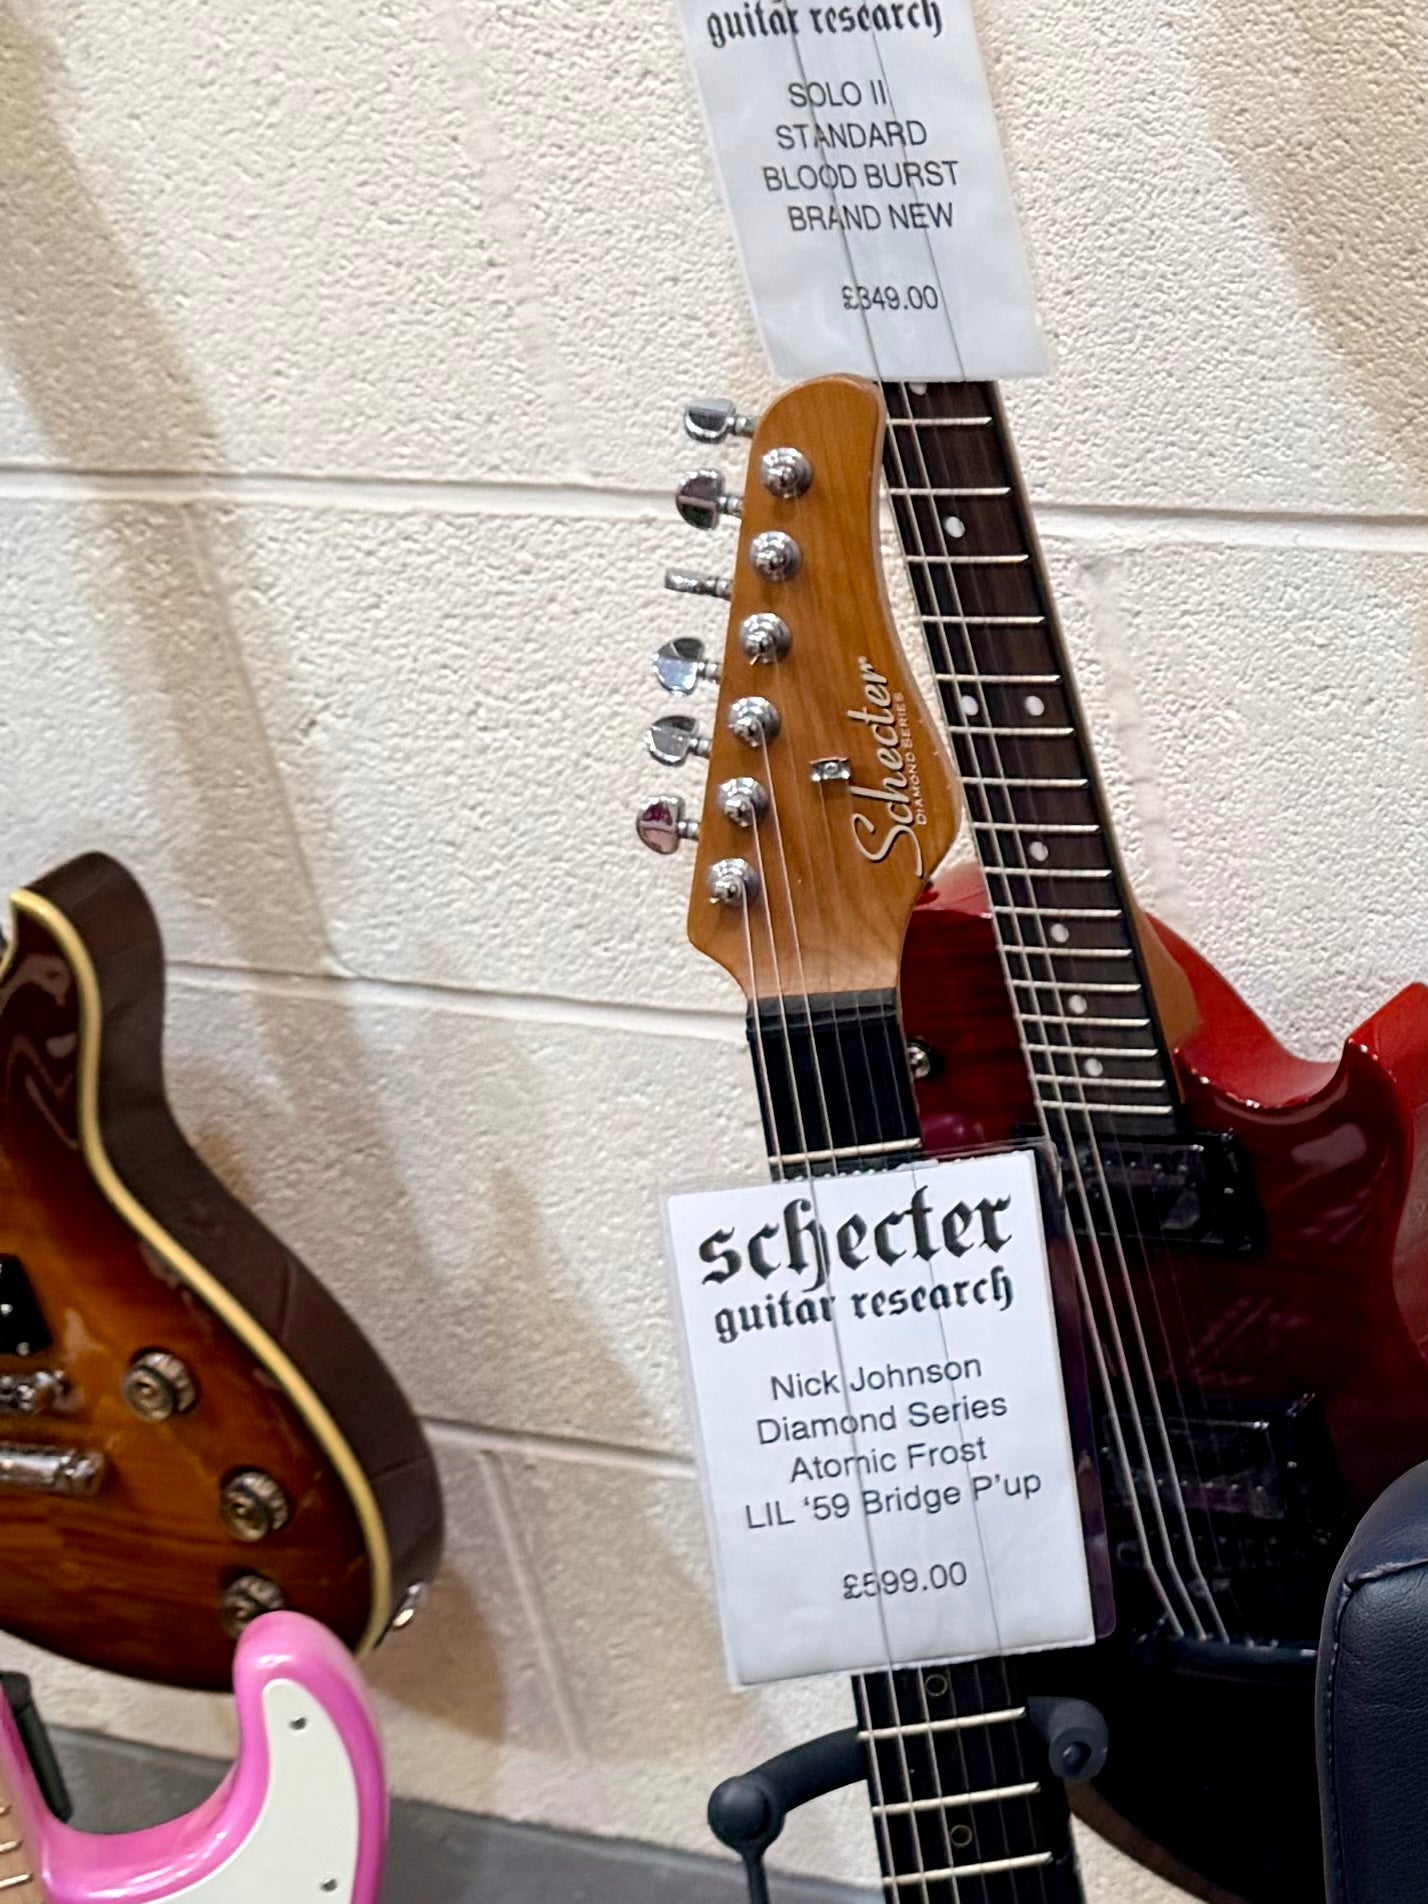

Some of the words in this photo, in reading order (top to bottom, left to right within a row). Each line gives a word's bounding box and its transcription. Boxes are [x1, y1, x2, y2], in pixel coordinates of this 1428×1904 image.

[788, 81, 862, 108] SOLO
[776, 120, 927, 150] STANDARD
[762, 163, 858, 192] BLOOD
[866, 160, 959, 188] BURST
[789, 204, 882, 233] BRAND
[891, 202, 954, 229] NEW
[892, 692, 914, 748] SERIES
[847, 656, 924, 878] Schecter
[907, 752, 928, 826] DIAMOND
[698, 1184, 1013, 1293] schecter
[713, 1290, 836, 1344] guitar
[850, 1264, 1014, 1320] research
[770, 1373, 841, 1401] Nick
[849, 1356, 983, 1394] Johnson
[756, 1407, 897, 1446] Diamond
[907, 1394, 1009, 1430] Series
[789, 1455, 897, 1484] Atomic
[907, 1437, 988, 1470] Frost
[746, 1504, 795, 1530] LIL
[862, 1483, 962, 1517] Bridge
[842, 1560, 969, 1600] £599.00
